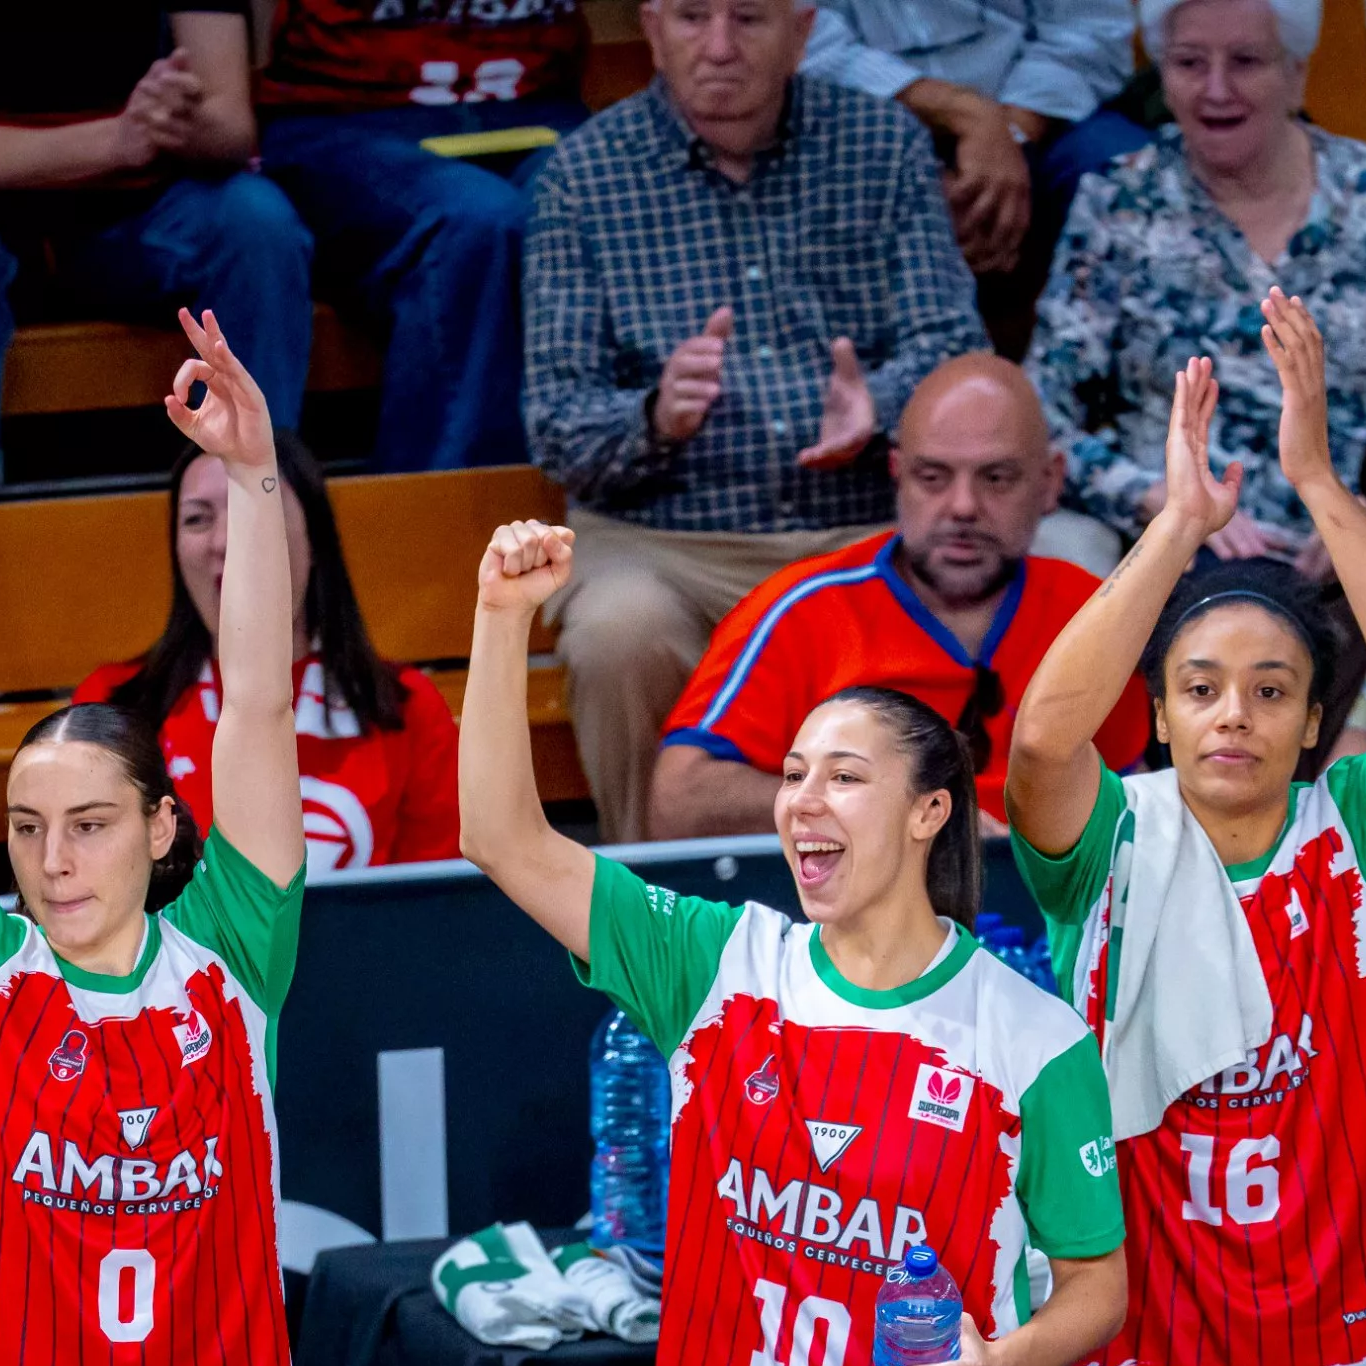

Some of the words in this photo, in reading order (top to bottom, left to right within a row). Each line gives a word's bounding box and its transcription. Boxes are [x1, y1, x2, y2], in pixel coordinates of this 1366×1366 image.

[813, 1126, 847, 1140] 1900
[23, 1190, 115, 1215] PEQUEÑOS
[717, 1156, 928, 1262] AMBAR
[1180, 1131, 1281, 1226] 16
[726, 1218, 796, 1253] EQUEÑOS
[98, 1248, 156, 1343] 0
